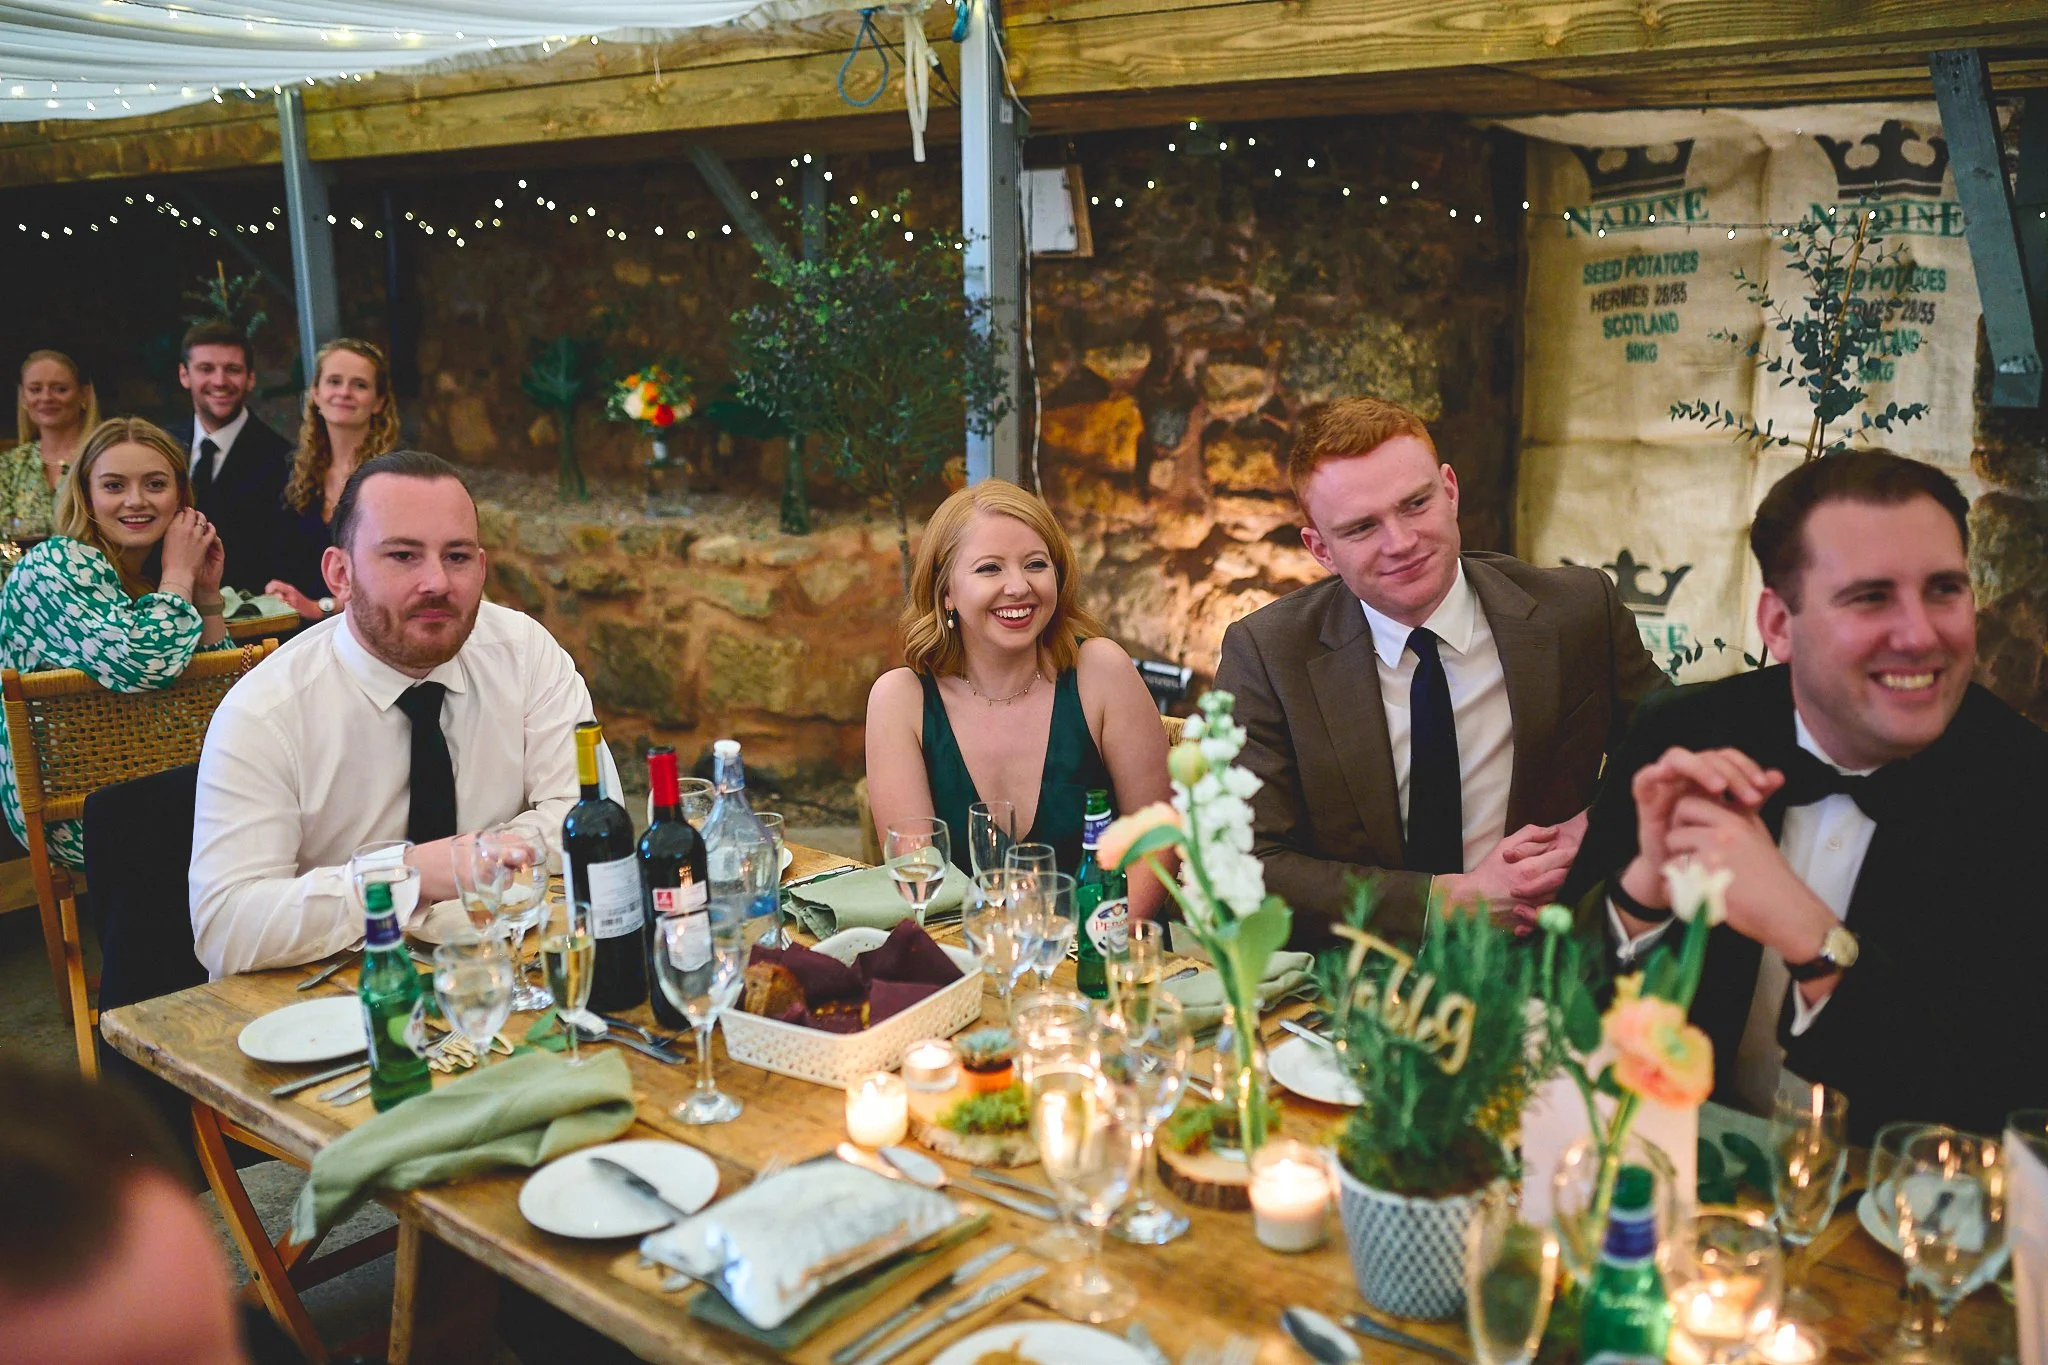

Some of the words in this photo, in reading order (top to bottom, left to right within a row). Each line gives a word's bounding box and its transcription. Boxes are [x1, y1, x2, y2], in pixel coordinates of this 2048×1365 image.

[1565, 187, 1708, 238] NADINE
[1583, 259, 1622, 285] SEED
[1625, 251, 1699, 278] POTATOES
[1591, 285, 1649, 313] HERMES
[1603, 311, 1679, 340] SCOTLAND
